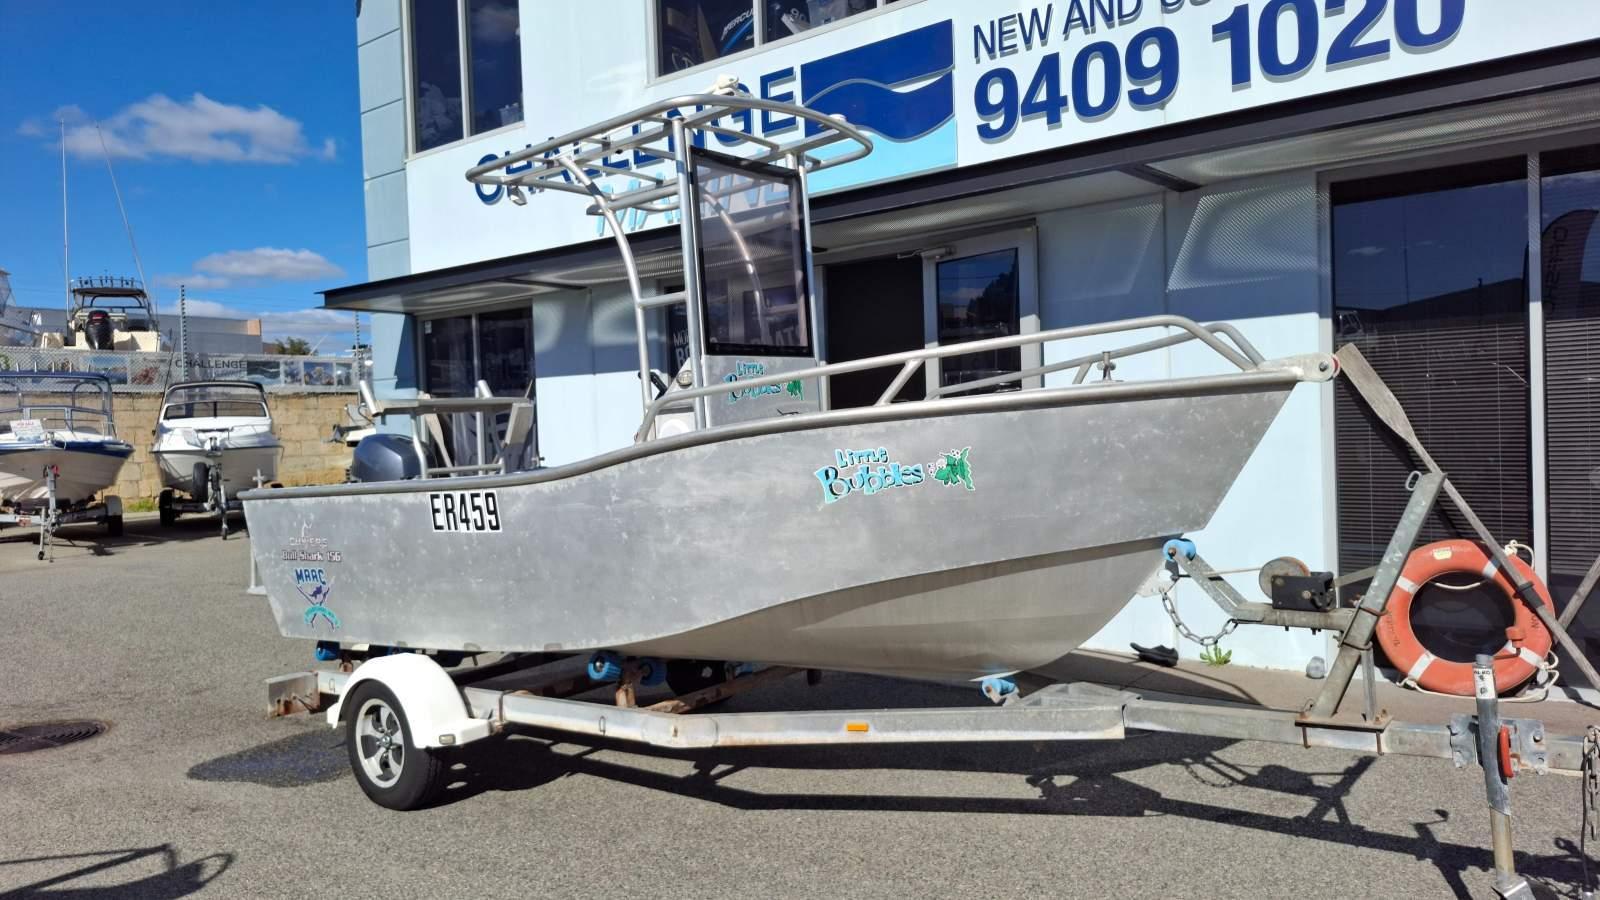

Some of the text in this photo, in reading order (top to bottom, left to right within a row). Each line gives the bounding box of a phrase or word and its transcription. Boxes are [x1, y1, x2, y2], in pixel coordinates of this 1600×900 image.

[973, 4, 1053, 64] NEW
[974, 0, 1465, 142] 9409 1020
[175, 359, 247, 369] CHALLENGE
[814, 462, 925, 504] Bubbles
[429, 492, 501, 531] ER459
[327, 551, 342, 562] 156
